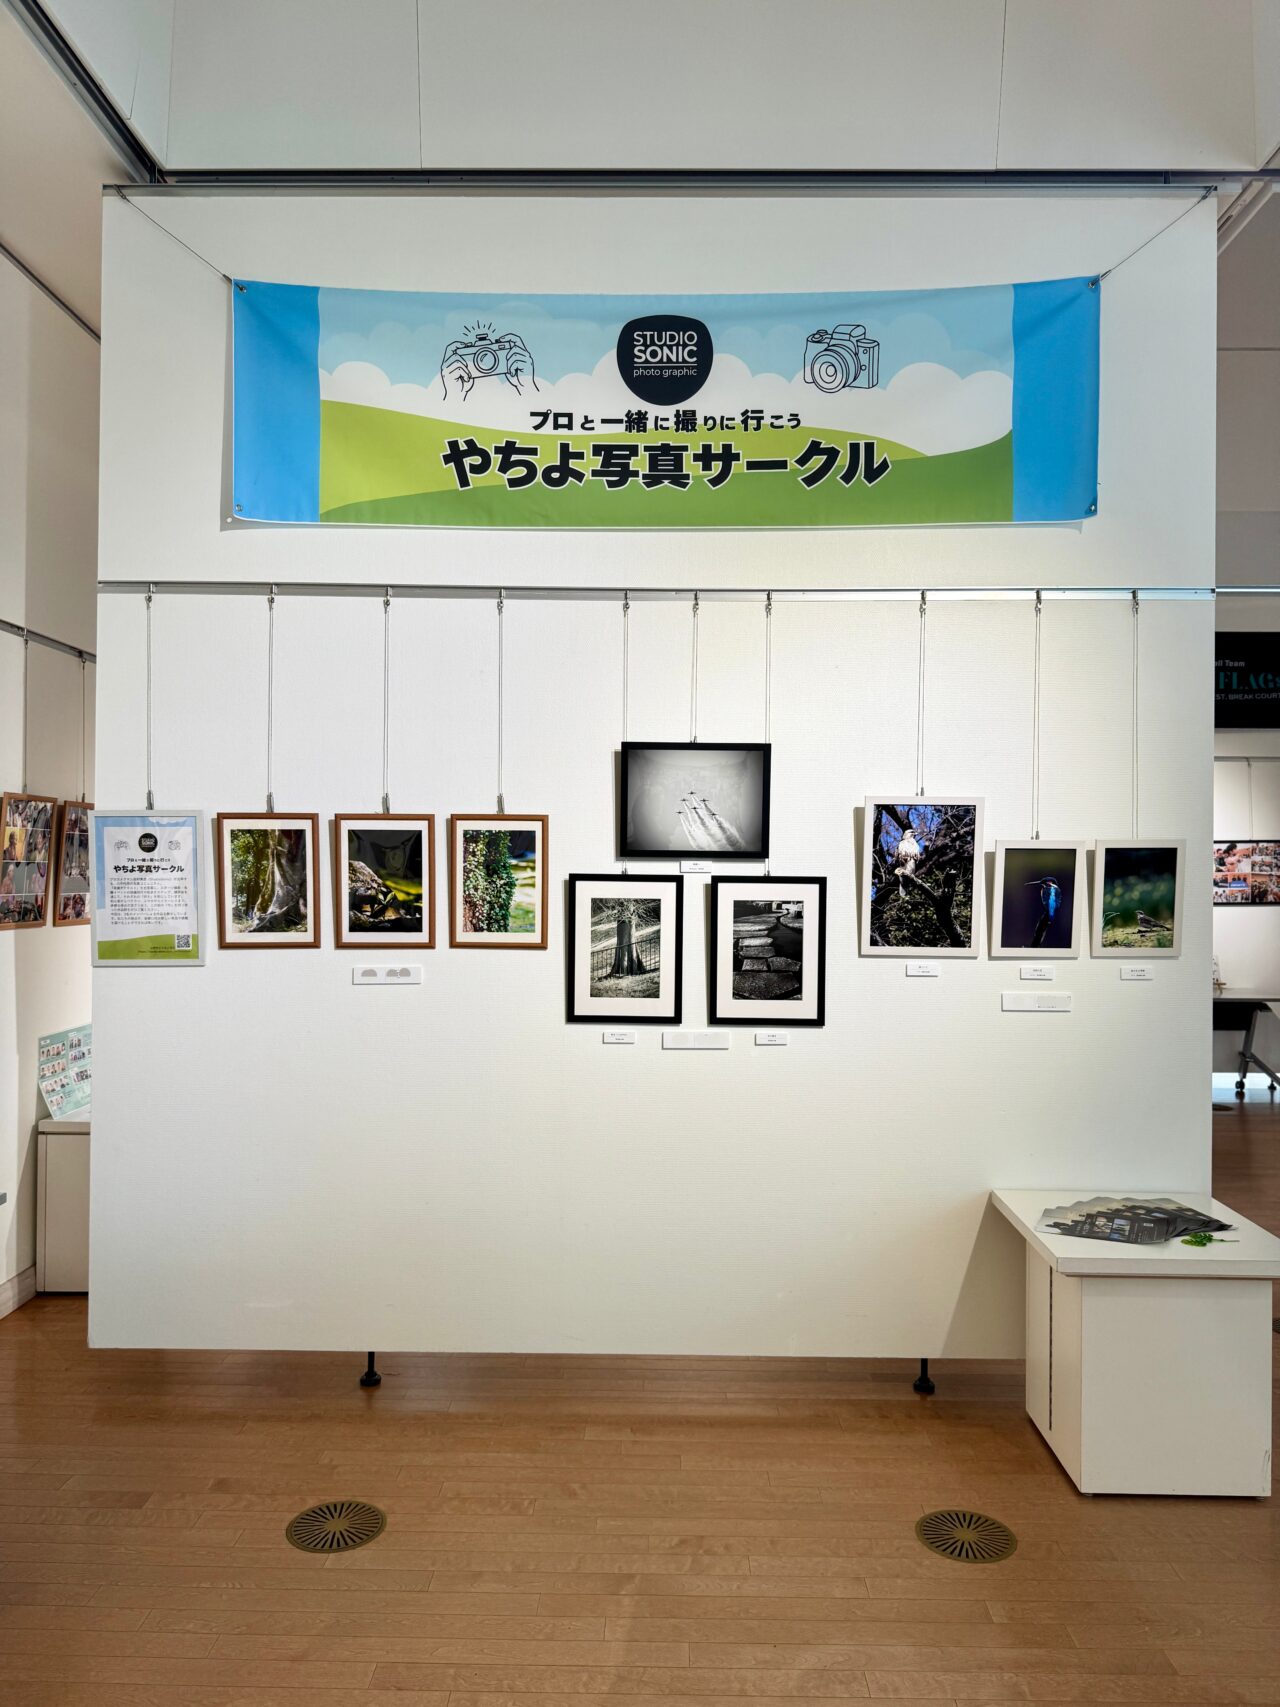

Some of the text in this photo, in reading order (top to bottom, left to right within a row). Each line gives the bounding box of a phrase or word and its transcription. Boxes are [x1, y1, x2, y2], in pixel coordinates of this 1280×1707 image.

[633, 331, 698, 345] STUDIO
[633, 346, 698, 363] SONIC
[633, 366, 698, 378] photo graphic
[441, 437, 892, 491] やちよ写真サークル
[113, 865, 185, 873] やちよ写真サークル
